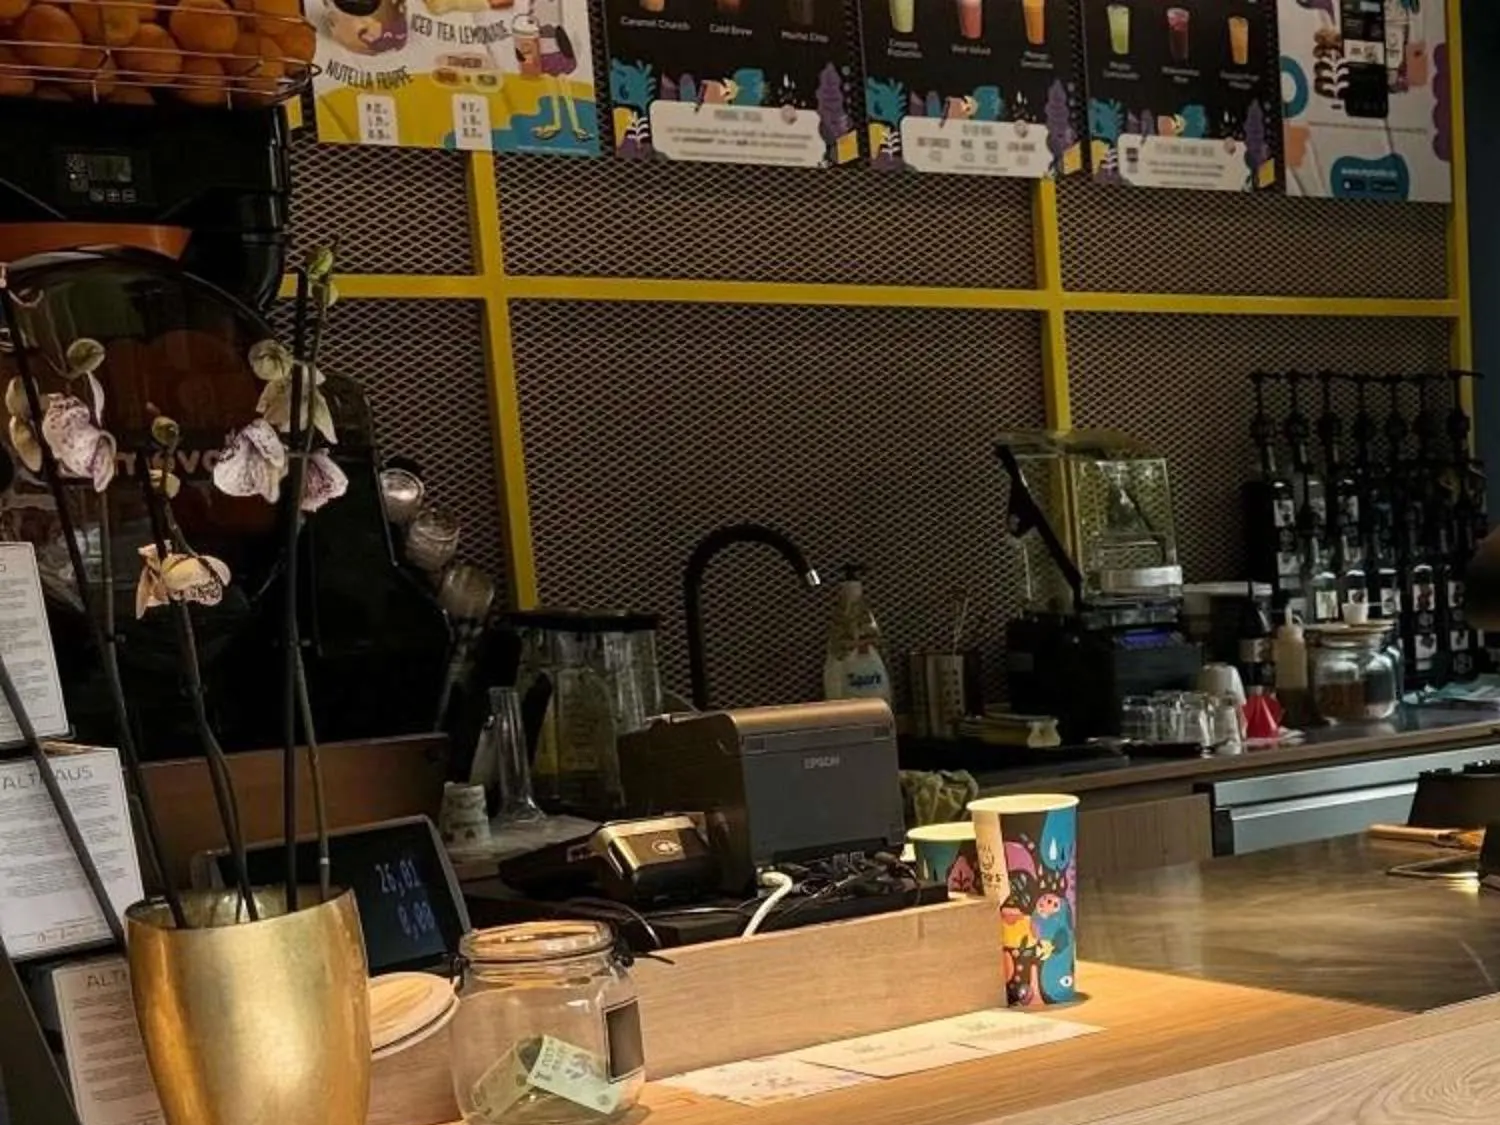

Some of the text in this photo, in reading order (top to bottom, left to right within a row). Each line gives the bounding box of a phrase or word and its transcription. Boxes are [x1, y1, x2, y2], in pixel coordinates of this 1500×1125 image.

[411, 14, 433, 38] ICED
[437, 22, 457, 43] TEA
[326, 59, 375, 89] NUTELLA
[3, 764, 94, 791] ALTAUS
